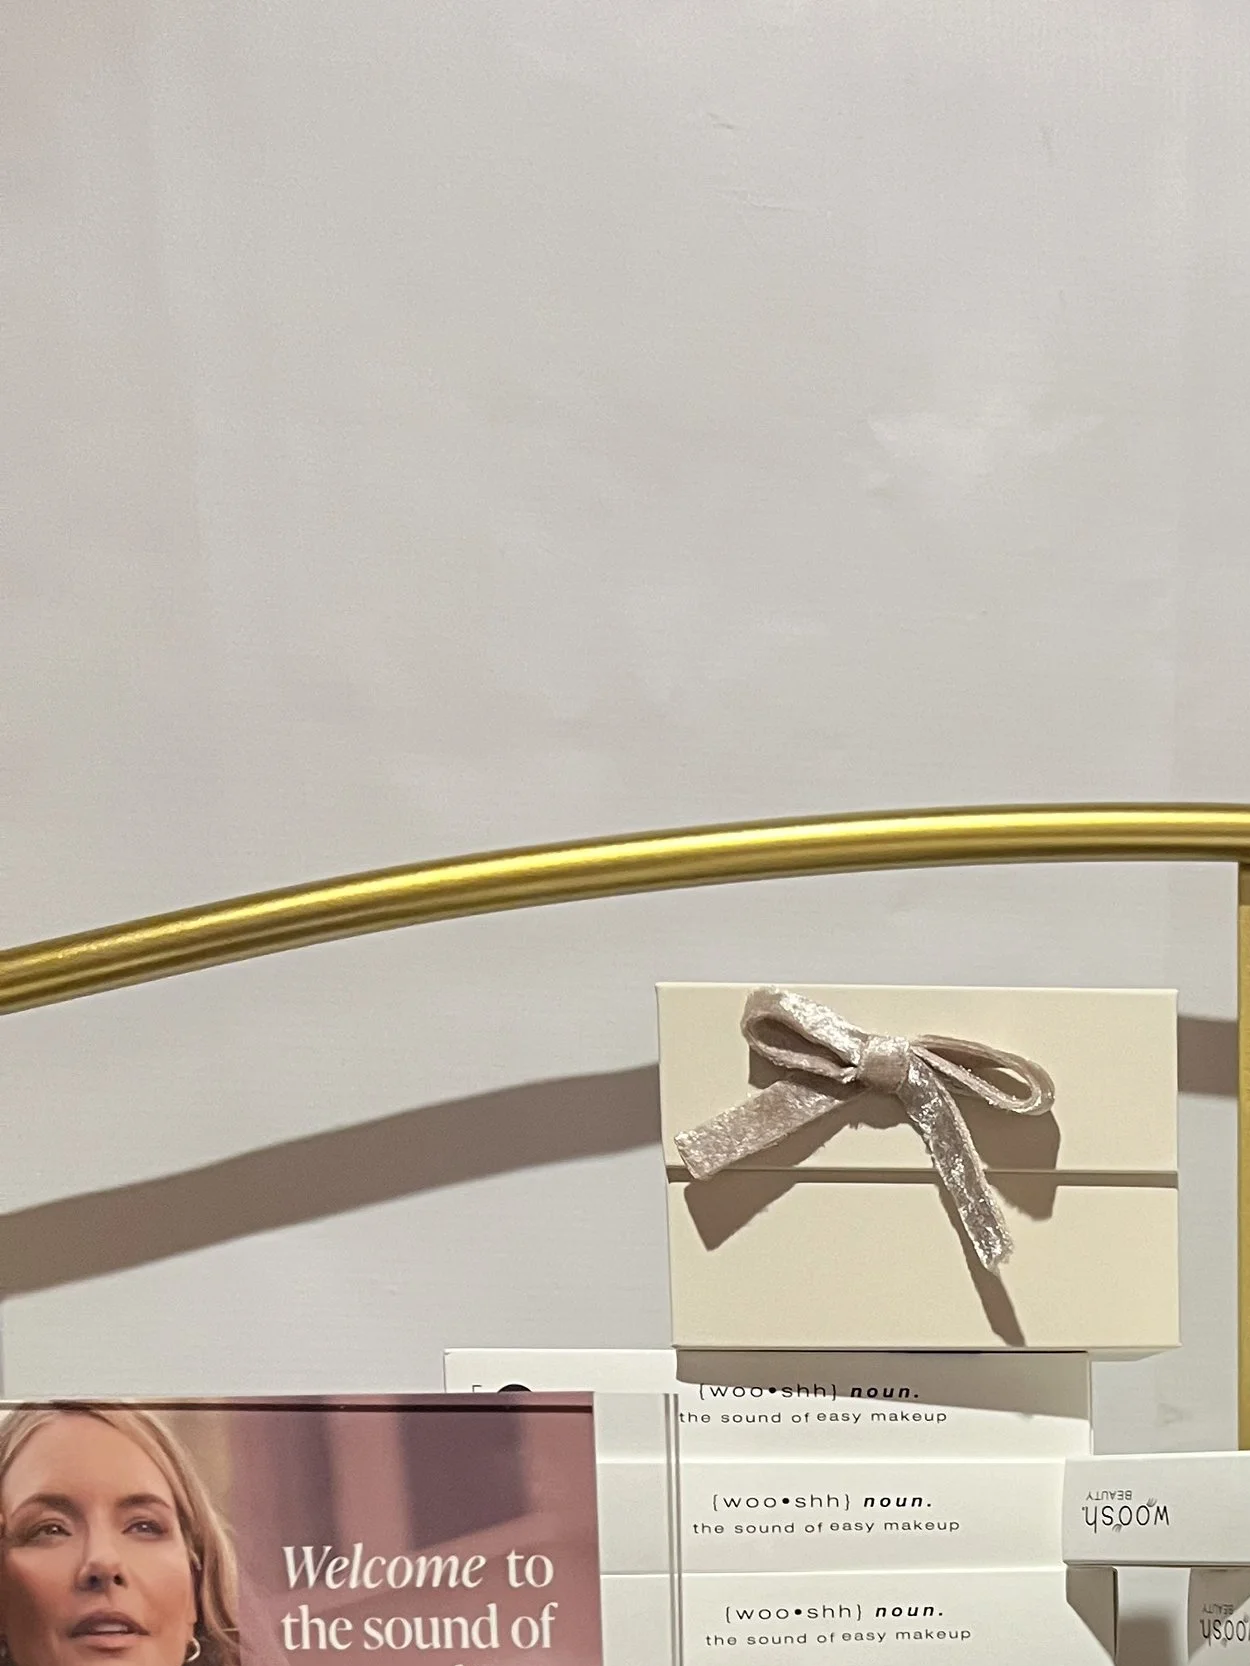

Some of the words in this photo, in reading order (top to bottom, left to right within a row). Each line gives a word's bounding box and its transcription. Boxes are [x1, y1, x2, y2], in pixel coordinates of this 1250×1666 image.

[850, 1385, 920, 1399] noun.
[679, 1411, 712, 1424] the
[720, 1411, 783, 1424] sound
[791, 1411, 811, 1424] of
[816, 1411, 862, 1424] easy
[870, 1409, 948, 1424] makeup
[863, 1495, 933, 1509] noun.
[1086, 1490, 1133, 1501] BEAUTY
[693, 1522, 725, 1535] the
[734, 1521, 796, 1535] sound
[804, 1521, 824, 1534] of
[829, 1520, 875, 1535] easy
[883, 1519, 960, 1534] makeup
[281, 1542, 487, 1590] Welcome
[506, 1548, 554, 1589] to
[875, 1604, 944, 1618] noun.
[280, 1604, 354, 1651] the
[362, 1603, 500, 1651] sound
[510, 1601, 559, 1650] of
[706, 1635, 738, 1646] the
[747, 1633, 808, 1646] sound
[816, 1632, 836, 1645] of
[841, 1630, 887, 1644] easy
[895, 1628, 972, 1642] makeup
